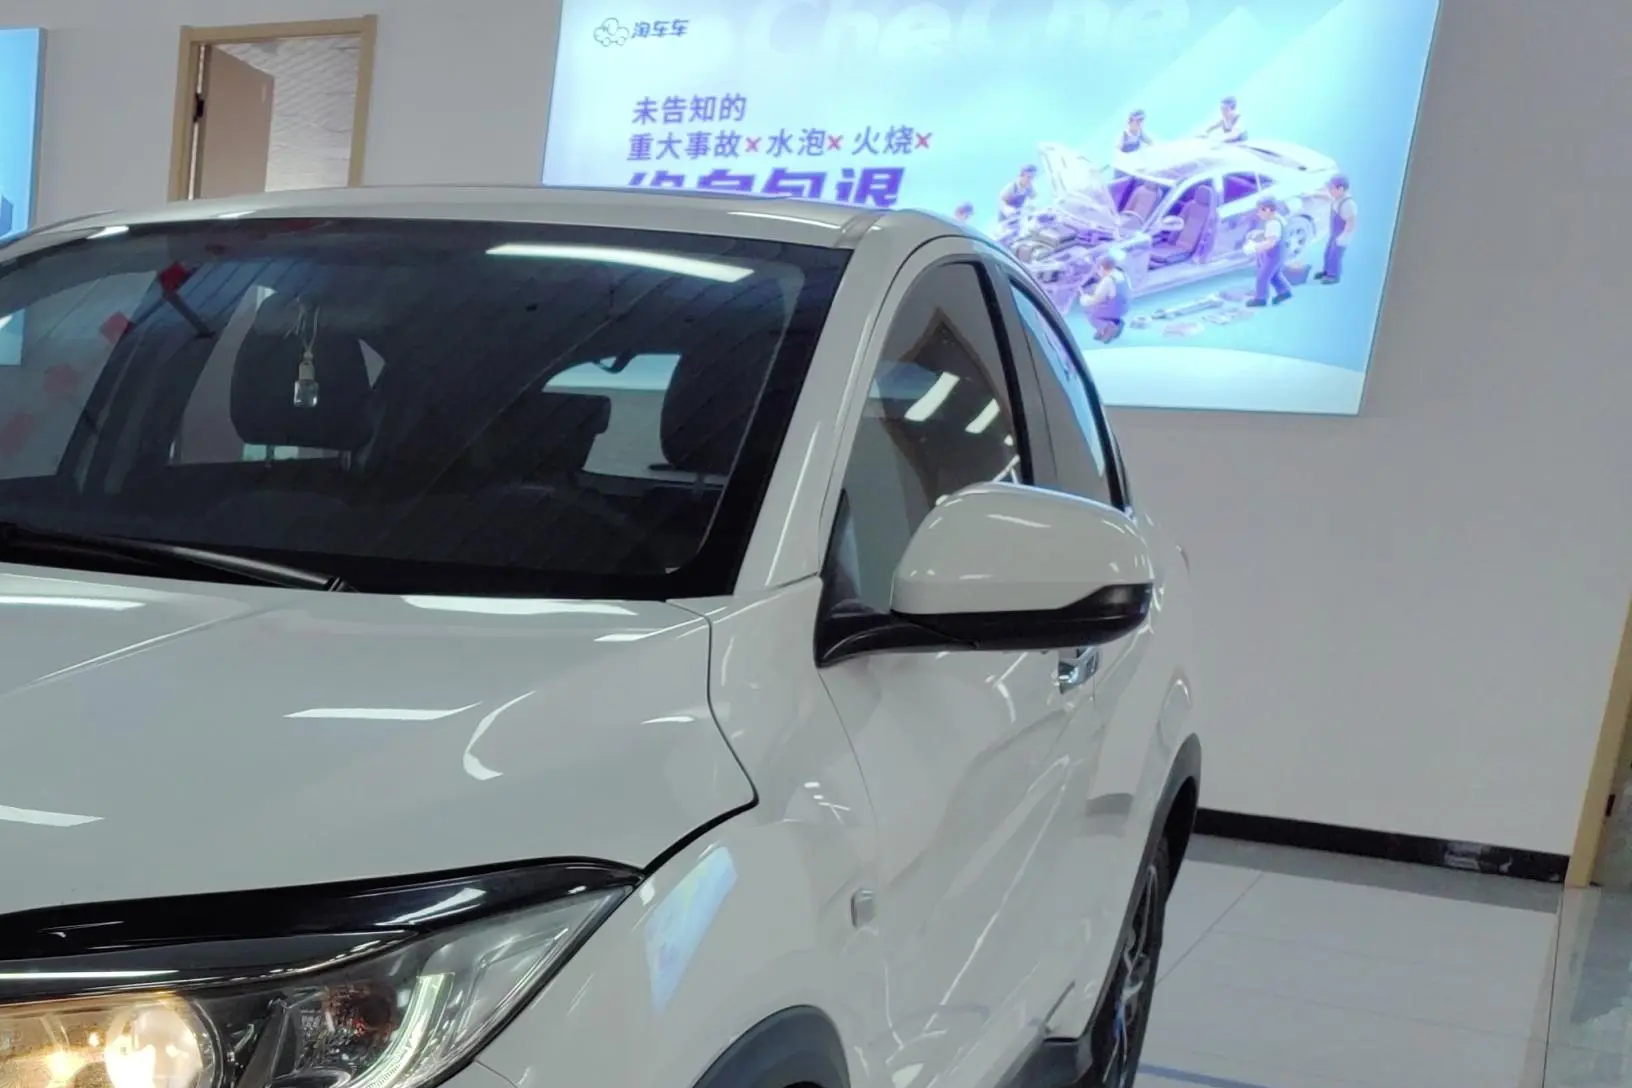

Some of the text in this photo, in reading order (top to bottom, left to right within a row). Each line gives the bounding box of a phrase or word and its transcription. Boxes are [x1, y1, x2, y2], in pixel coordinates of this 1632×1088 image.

[631, 19, 688, 39] 淘车车
[632, 92, 748, 125] 未告知的
